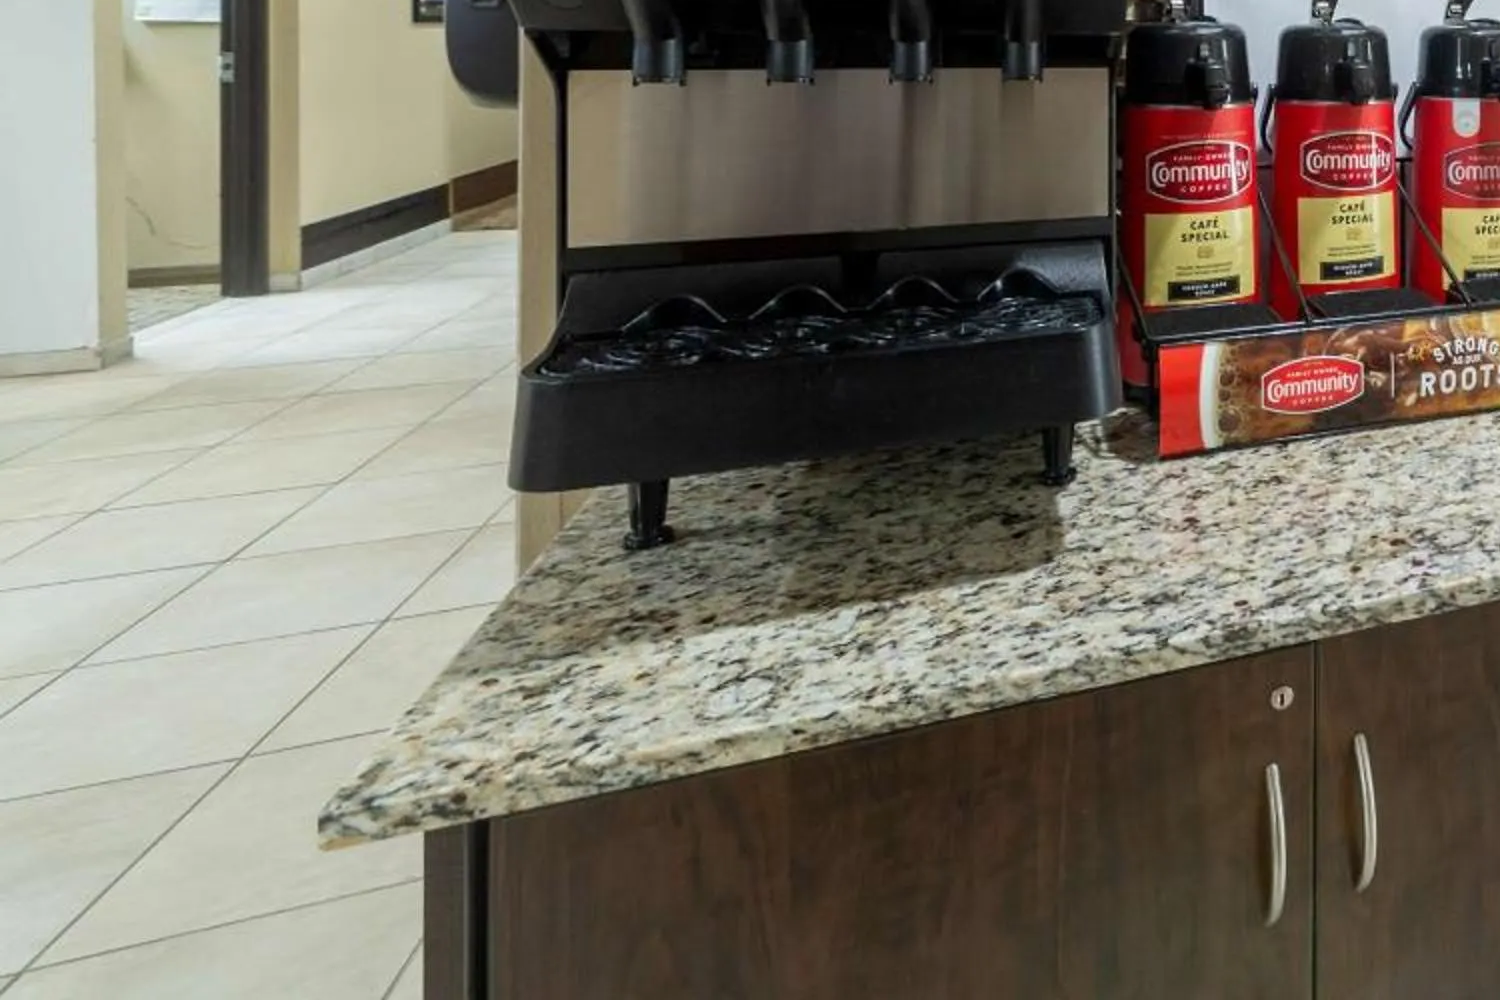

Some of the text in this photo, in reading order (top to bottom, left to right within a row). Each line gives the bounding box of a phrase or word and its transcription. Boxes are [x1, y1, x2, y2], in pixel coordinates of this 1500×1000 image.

[1306, 148, 1391, 174] Community
[1152, 161, 1249, 188] Communty
[1189, 216, 1219, 231] CAFÉ
[1331, 214, 1374, 225] SPECIAL
[1181, 231, 1229, 243] SPECIAL
[1433, 336, 1500, 362] STRONG
[1267, 371, 1359, 403] Community
